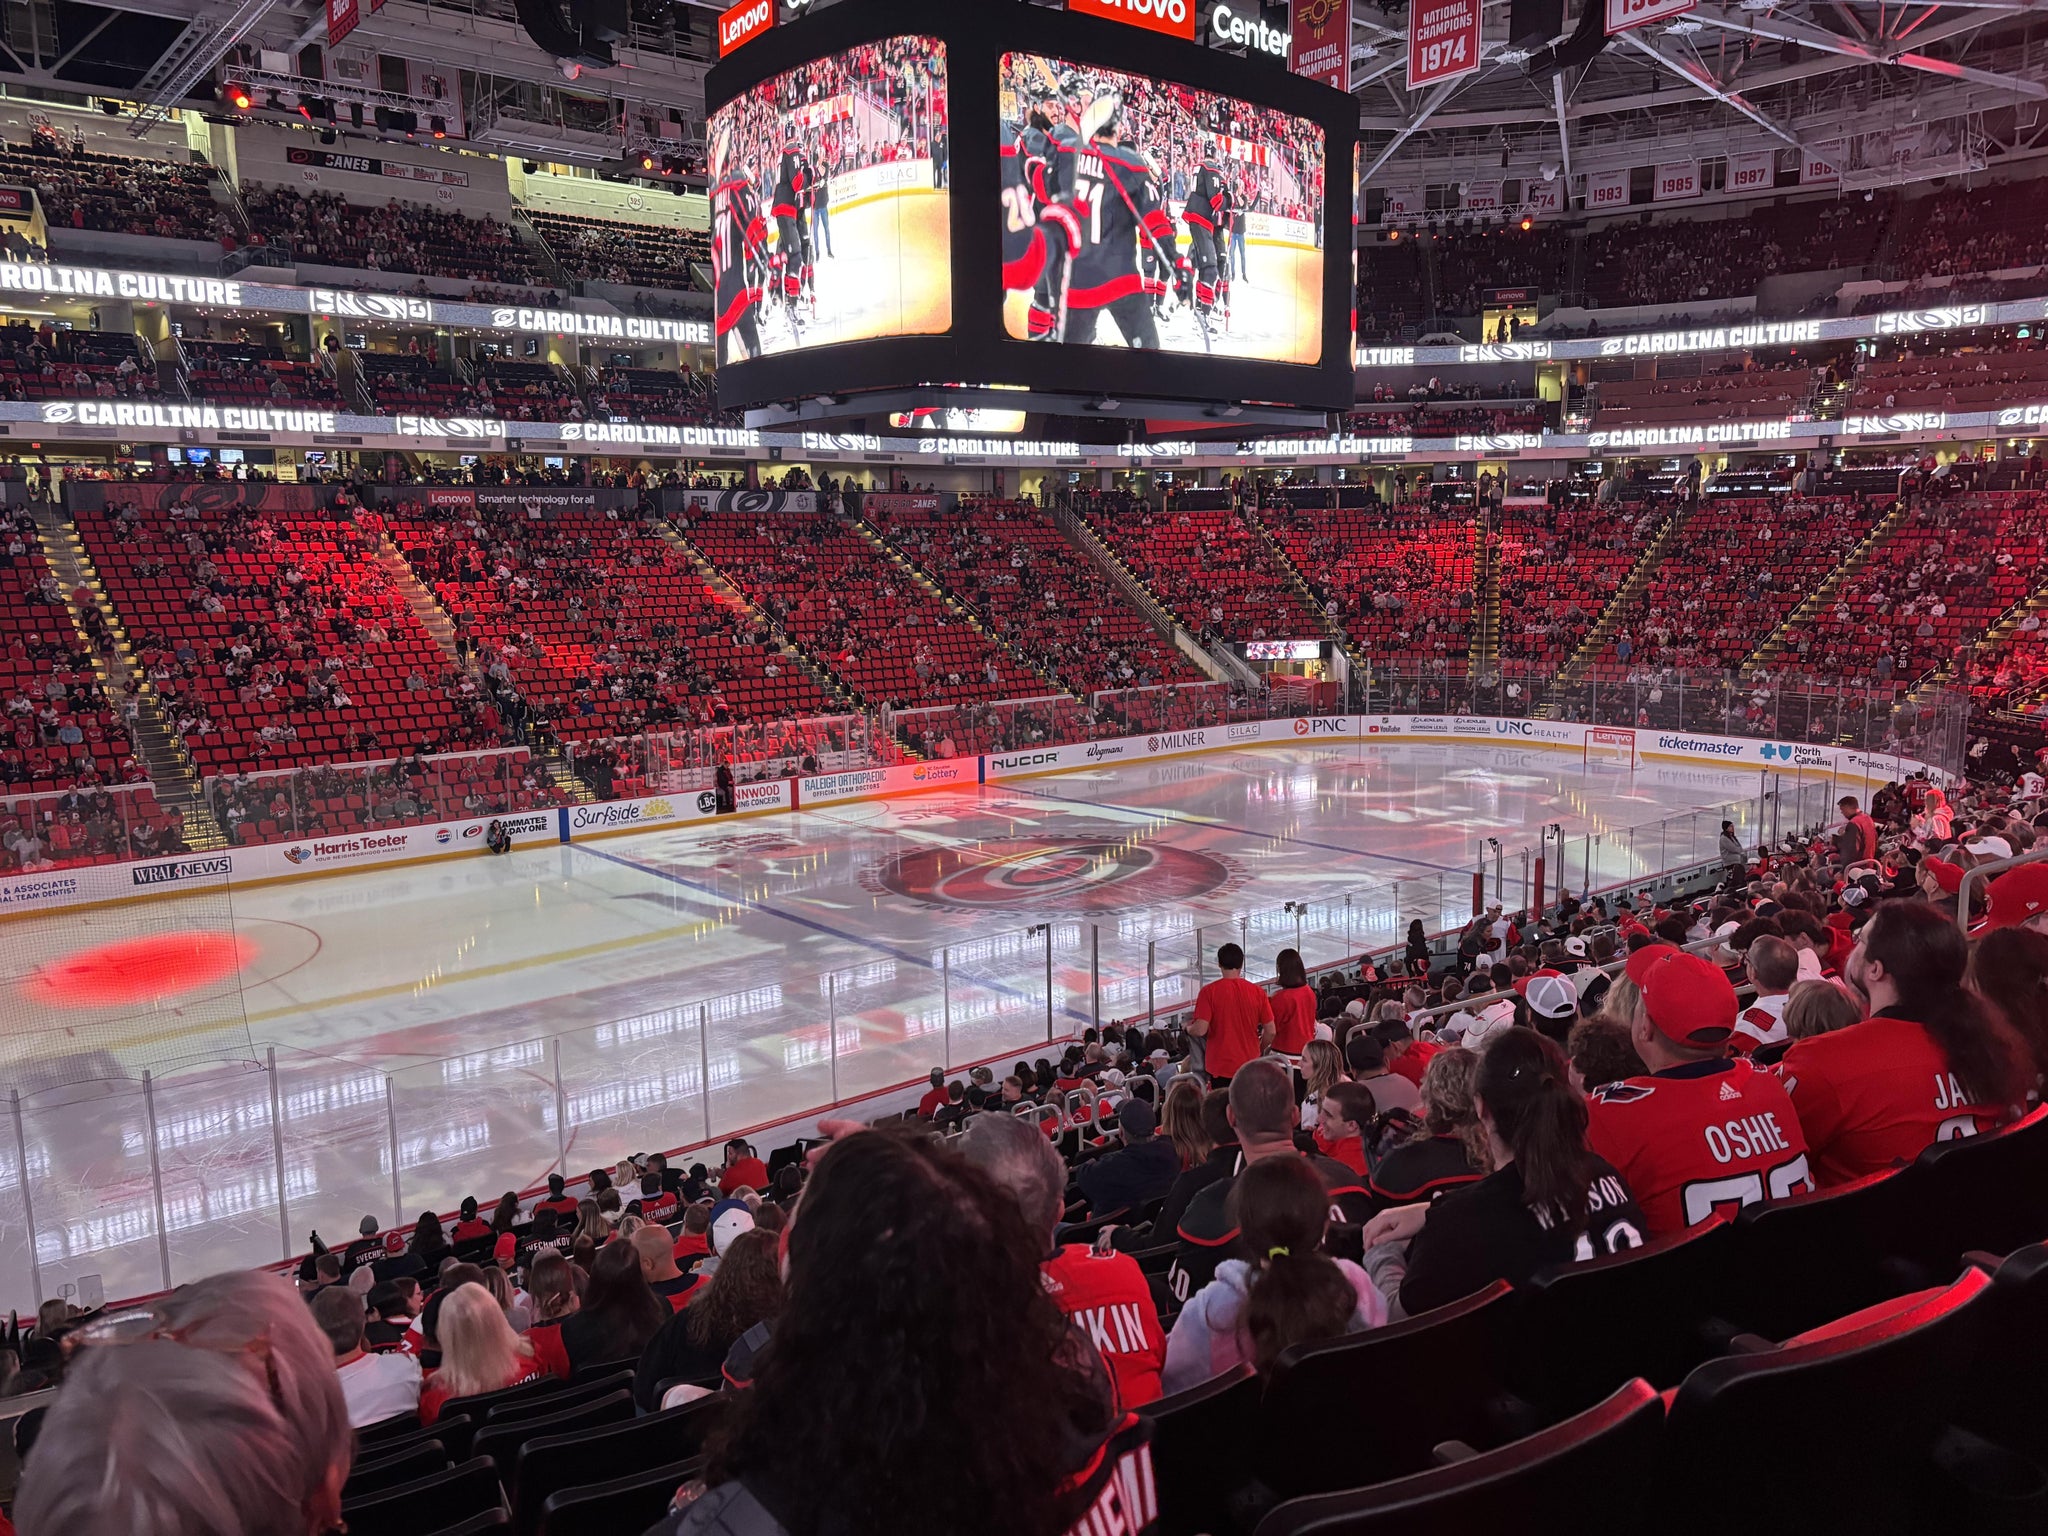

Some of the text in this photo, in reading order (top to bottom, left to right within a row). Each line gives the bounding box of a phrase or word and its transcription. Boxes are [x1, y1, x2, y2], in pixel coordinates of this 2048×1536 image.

[722, 2, 769, 46] Lenovo
[1423, 5, 1468, 26] NATIONAL
[1101, 0, 1292, 58] novo Center
[1417, 13, 1472, 41] CHAMPIONS
[1298, 43, 1338, 66] NATIONAL
[1421, 35, 1467, 73] 1974
[325, 154, 370, 172] CANES
[1077, 154, 1104, 179] HALL
[880, 166, 913, 181] SILAC
[1734, 168, 1766, 186] 1987
[1593, 186, 1622, 202] 1983
[1662, 177, 1693, 193] 1985
[0, 263, 242, 305] ROLINA CULTURE
[1497, 291, 1524, 300] Lenovo
[518, 308, 709, 343] CAROLINA CULTURE
[1625, 320, 1820, 355] CAROLINA CULTURE
[78, 402, 335, 433] CAROLINA CULTURE
[584, 422, 760, 447] CAROLINA CULTURE
[1609, 421, 1792, 447] CAROLINA CULTURE
[937, 438, 1080, 456] CAROLINA CULTURE
[1255, 438, 1413, 455] CAROLINA CULTURE
[431, 493, 595, 507] Lenovo Smarter technology for all
[912, 499, 937, 509] CANES
[1230, 725, 1258, 737] SILAC
[1312, 718, 1346, 733] PNC
[1379, 725, 1400, 733] YouTube
[1496, 720, 1570, 739] UNC HEALTH
[1161, 732, 1205, 750] MILNER
[1659, 735, 1743, 756] ticketmaster
[1087, 744, 1124, 761] Wegmans
[1794, 745, 1821, 756] North
[992, 753, 1058, 770] NUCOR
[1794, 755, 1832, 767] Carolina
[804, 770, 886, 791] RALEIGH ORTHOPAEDIC
[927, 768, 958, 779] Lottery
[812, 783, 880, 797] OFFICIAL TEAM DOCTORS
[700, 794, 716, 808] LBC
[751, 796, 780, 806] CONCERN
[500, 816, 547, 829] AMMATES
[573, 803, 640, 828] Surfside
[529, 823, 547, 833] ONE
[313, 834, 408, 857] Harris Teeter
[382, 846, 407, 855] MARKET
[134, 860, 229, 885] WRAL NEWS
[14, 879, 77, 893] ASSOCIATES
[15, 892, 41, 901] TEAM
[42, 887, 78, 897] DENTIST
[1704, 1112, 1790, 1163] OSHIE
